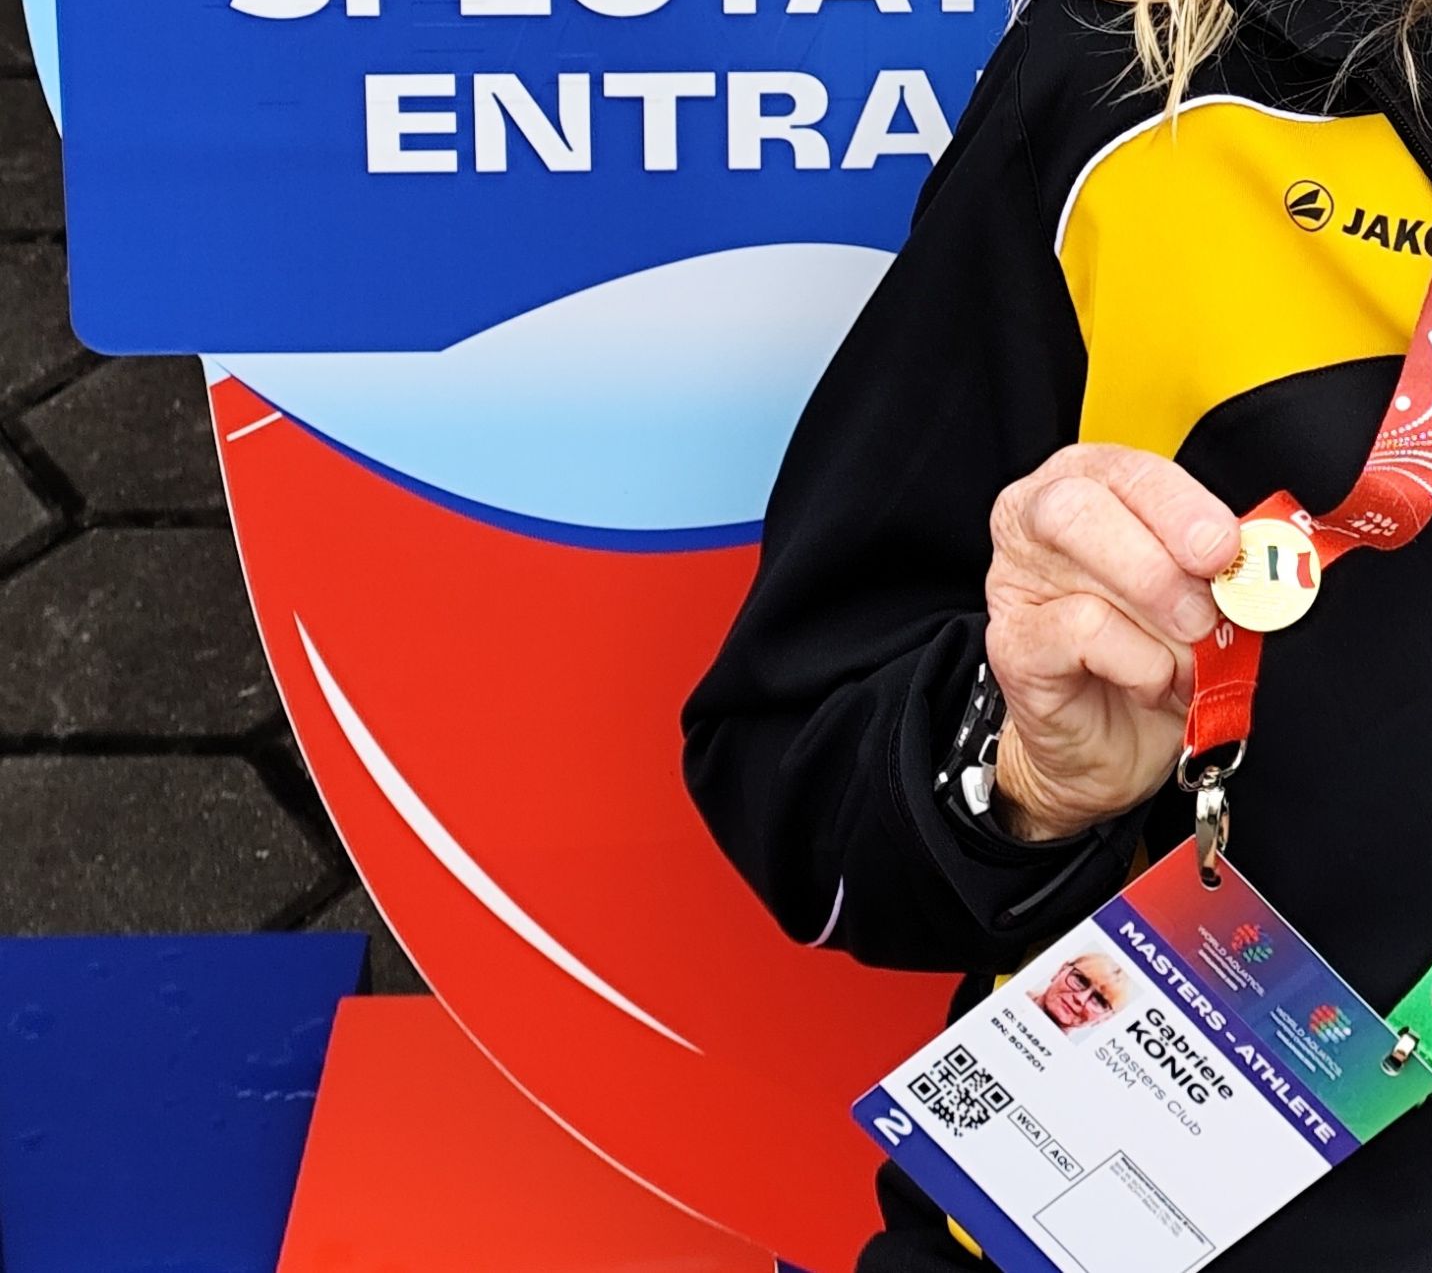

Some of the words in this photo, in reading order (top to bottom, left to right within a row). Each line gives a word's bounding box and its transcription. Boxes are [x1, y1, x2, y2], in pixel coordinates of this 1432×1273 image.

[364, 68, 986, 174] ENTRA
[1094, 1046, 1138, 1090] SWM
[1118, 920, 1227, 1032] MASTERS
[1234, 1043, 1337, 1145] ATHLETE
[1126, 1020, 1211, 1106] KÖNIG
[1145, 1007, 1234, 1100] Gabriele
[873, 1108, 913, 1147] 2
[1016, 1111, 1042, 1141] WCA
[1105, 1037, 1168, 1101] Masters
[1166, 1099, 1203, 1137] Club
[1049, 1148, 1076, 1173] AQC
